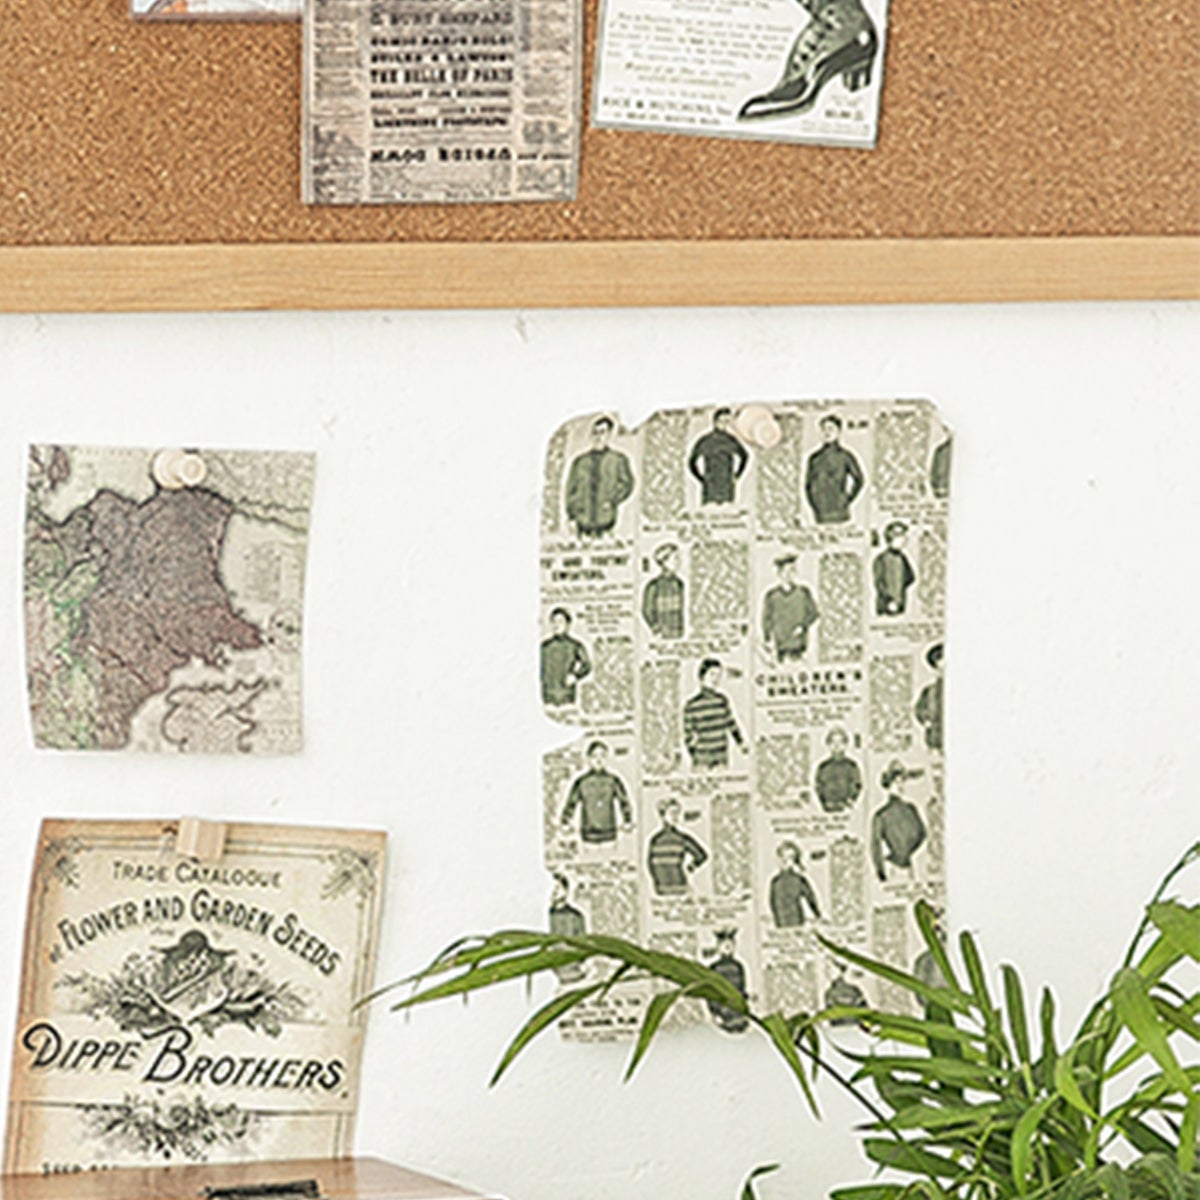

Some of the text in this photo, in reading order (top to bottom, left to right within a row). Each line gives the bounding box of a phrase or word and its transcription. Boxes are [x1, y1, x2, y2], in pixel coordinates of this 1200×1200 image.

[113, 861, 283, 888] TRADE CATALOGUE
[58, 903, 138, 952] FLOWER
[142, 895, 184, 922] AND
[190, 888, 272, 935] GARDEN
[273, 912, 342, 976] SEEDS
[22, 1022, 349, 1100] DIPPE BROTHERS.
